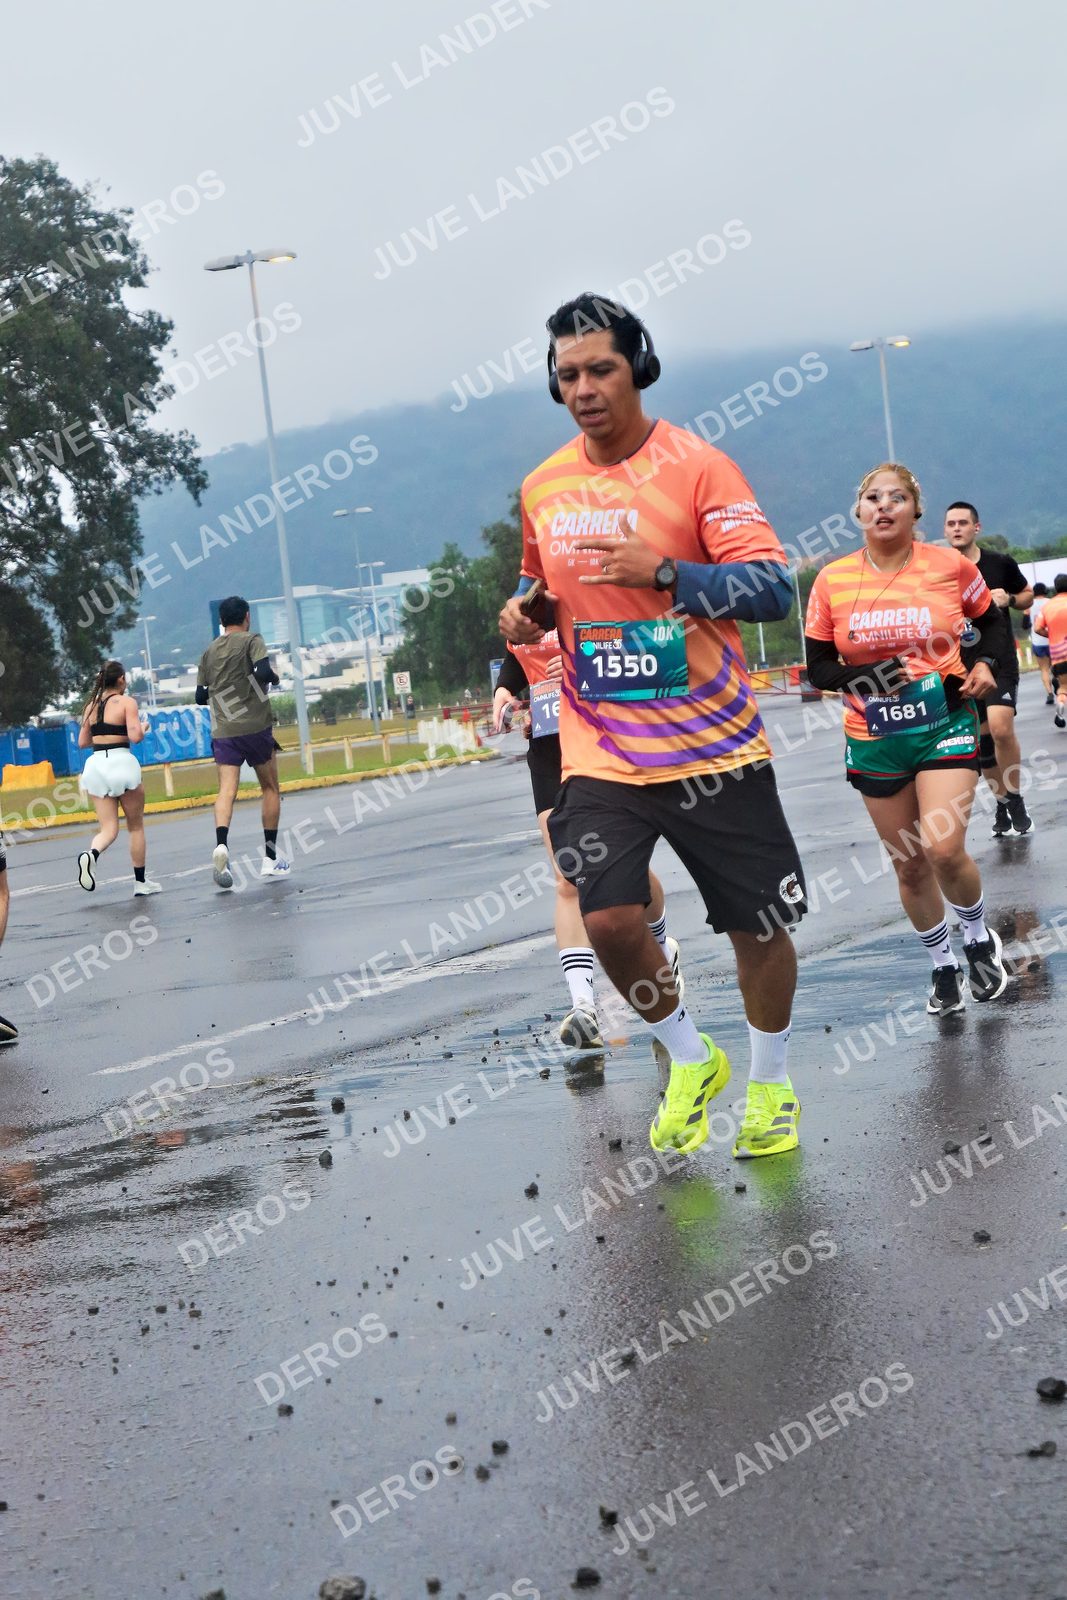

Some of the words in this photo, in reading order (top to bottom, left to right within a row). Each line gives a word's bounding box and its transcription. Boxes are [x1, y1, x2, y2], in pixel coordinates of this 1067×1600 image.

[849, 607, 932, 631] CARRERA
[580, 628, 623, 641] CARRERA
[653, 626, 675, 642] 10K
[851, 628, 914, 645] OMNILIFE
[592, 654, 658, 678] 1550
[921, 676, 936, 692] 10K
[878, 701, 928, 722] 1681
